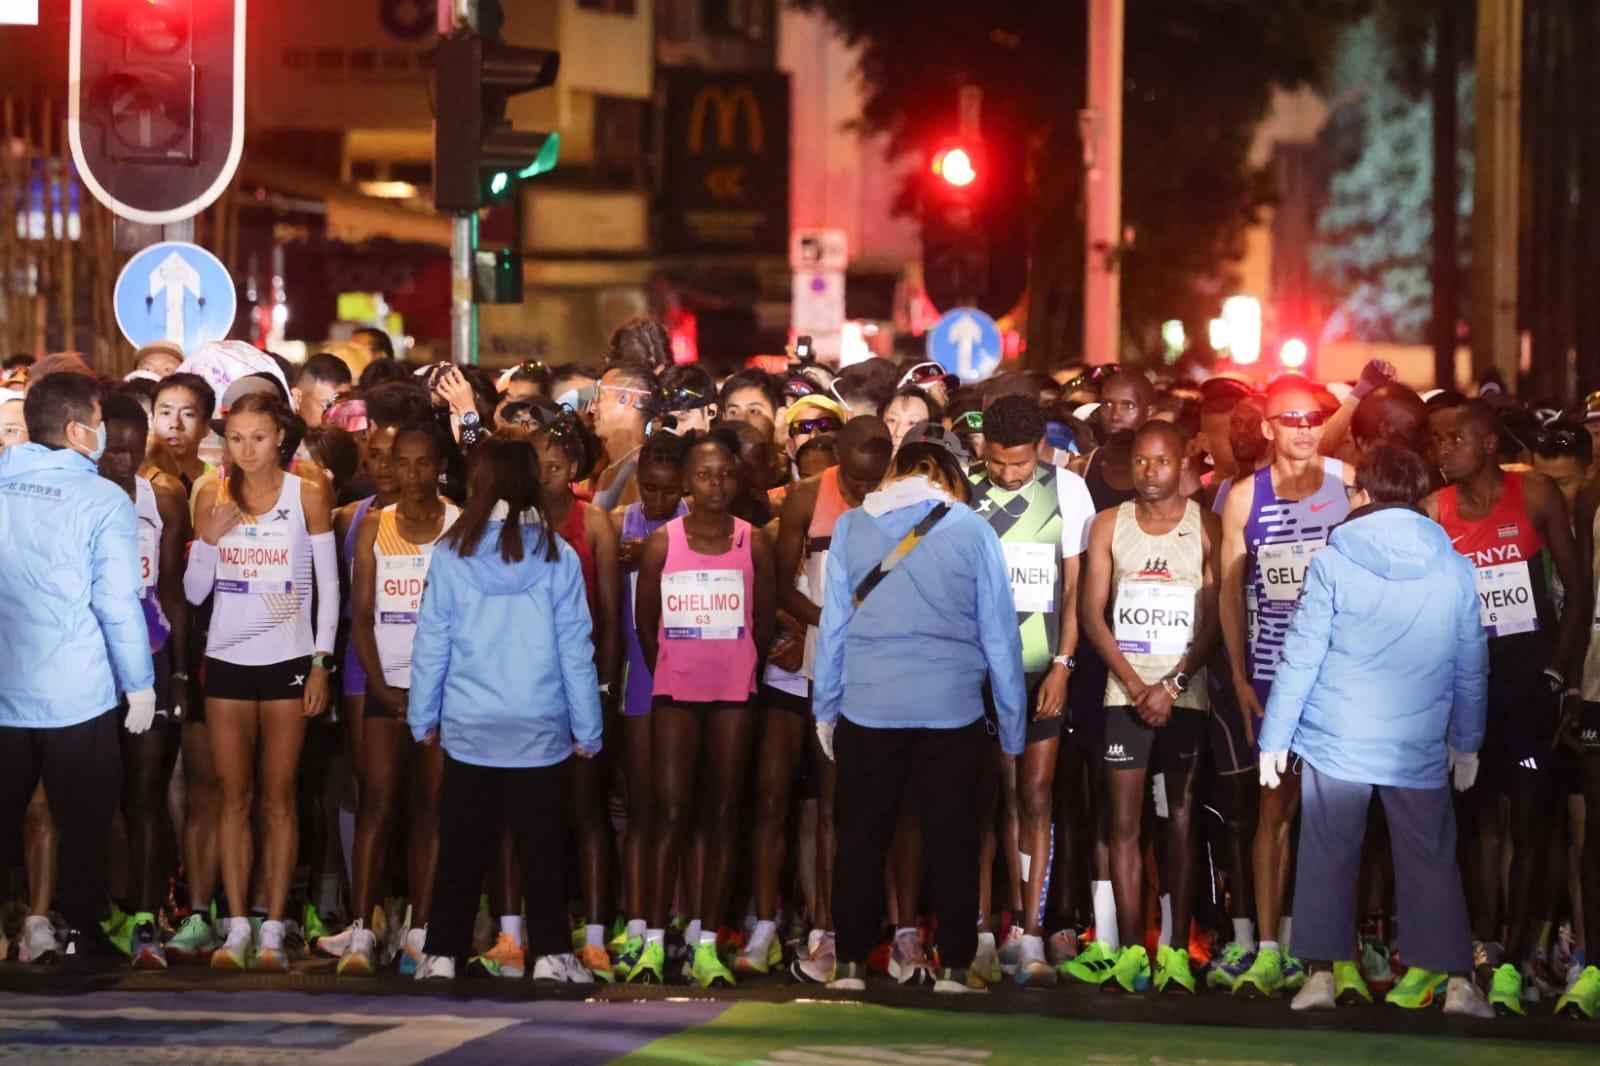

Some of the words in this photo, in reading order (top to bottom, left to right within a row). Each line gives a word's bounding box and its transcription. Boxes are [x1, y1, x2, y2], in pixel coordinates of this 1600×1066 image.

[219, 547, 288, 565] MAZURONAK
[141, 556, 150, 578] 3
[243, 569, 257, 578] 64
[384, 579, 421, 596] GUD
[667, 593, 740, 611] CHELIMO
[1480, 587, 1529, 609] YEKO
[695, 615, 711, 624] 63
[1119, 608, 1190, 627] KORIR
[1489, 613, 1498, 622] 6
[1145, 630, 1158, 639] 11
